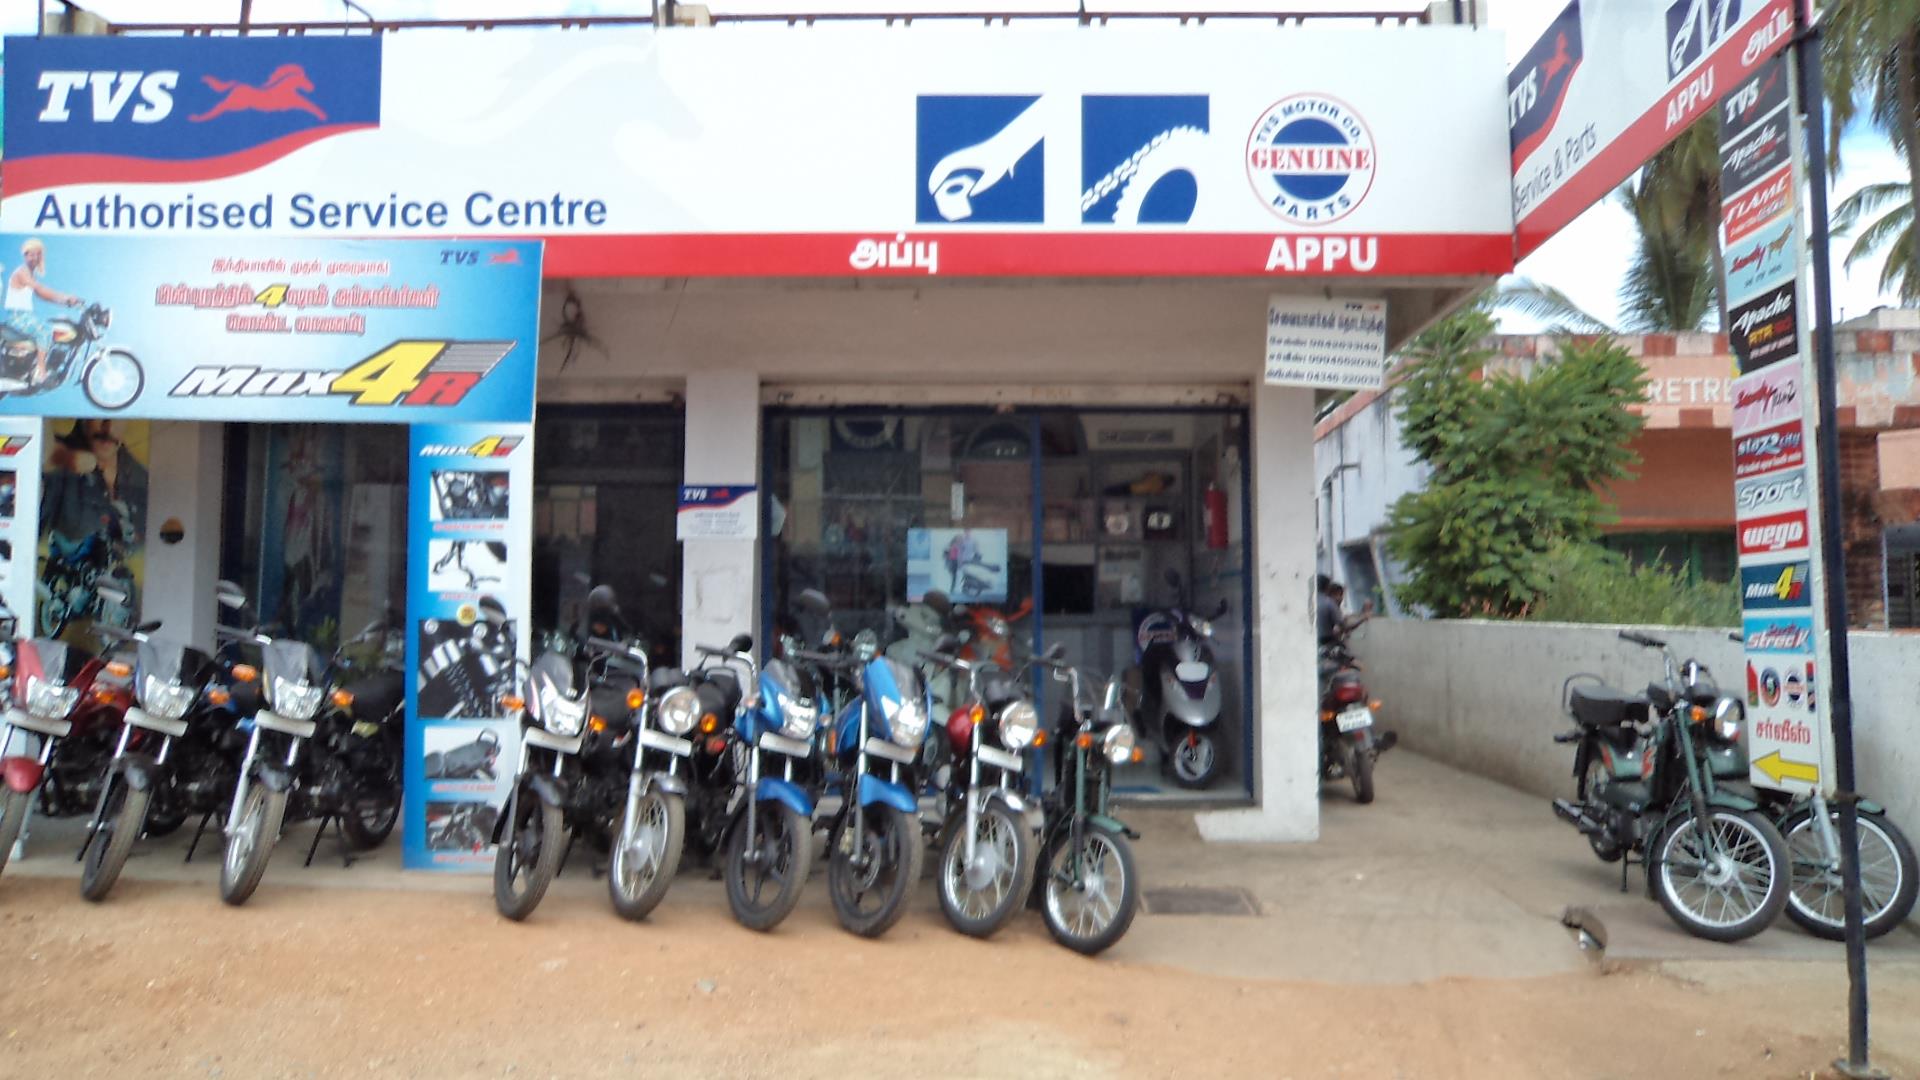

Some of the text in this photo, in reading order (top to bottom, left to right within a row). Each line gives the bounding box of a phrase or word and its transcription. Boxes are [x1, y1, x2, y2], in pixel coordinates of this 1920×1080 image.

[38, 71, 179, 123] TVS
[1282, 100, 1340, 118] MOTOR
[1509, 66, 1537, 129] TVS
[1665, 66, 1714, 131] APPU
[1725, 77, 1760, 124] TVS
[1251, 149, 1370, 169] GENUINE
[1554, 148, 1562, 180] &
[1565, 120, 1596, 168] Parts
[35, 190, 607, 229] Authorised Service Centre
[1272, 194, 1351, 219] PARTS
[440, 251, 479, 265] TVS
[849, 230, 938, 275] அப்பு
[1265, 236, 1378, 271] APPU
[1731, 291, 1791, 336] Apache
[683, 488, 708, 501] TVS
